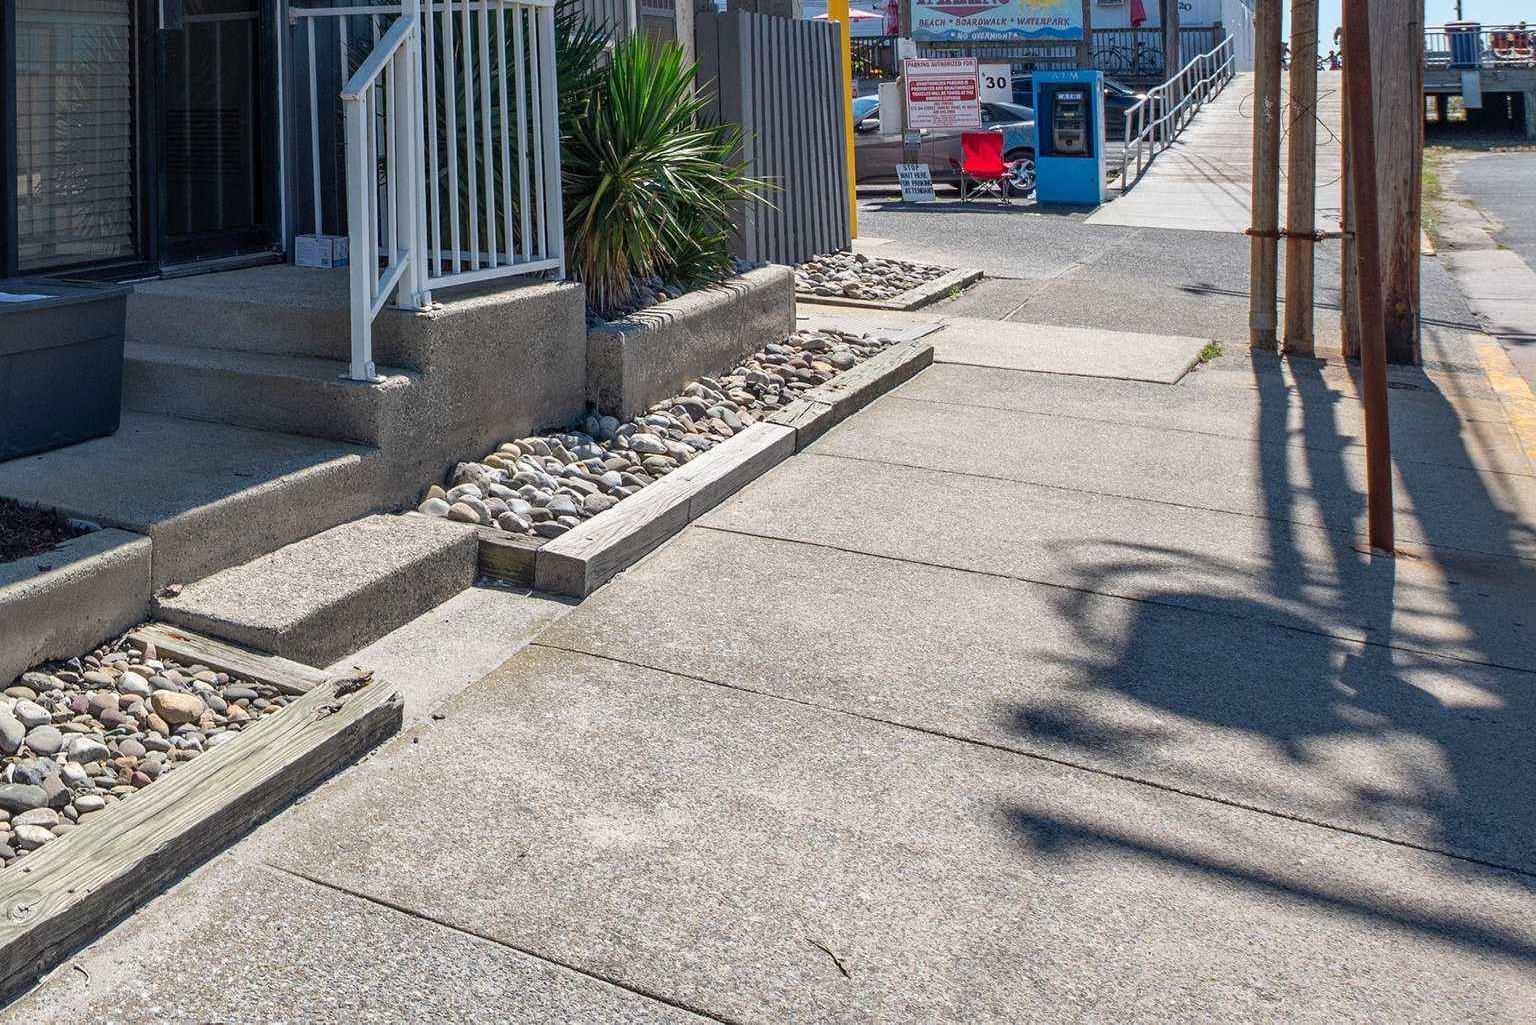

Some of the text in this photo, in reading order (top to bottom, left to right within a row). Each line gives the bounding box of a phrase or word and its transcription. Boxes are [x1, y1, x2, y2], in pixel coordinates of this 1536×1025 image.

[956, 18, 1007, 26] BOARDWALK
[1017, 17, 1070, 26] WATERPARK
[957, 32, 1013, 40] NO OVERNIGHT
